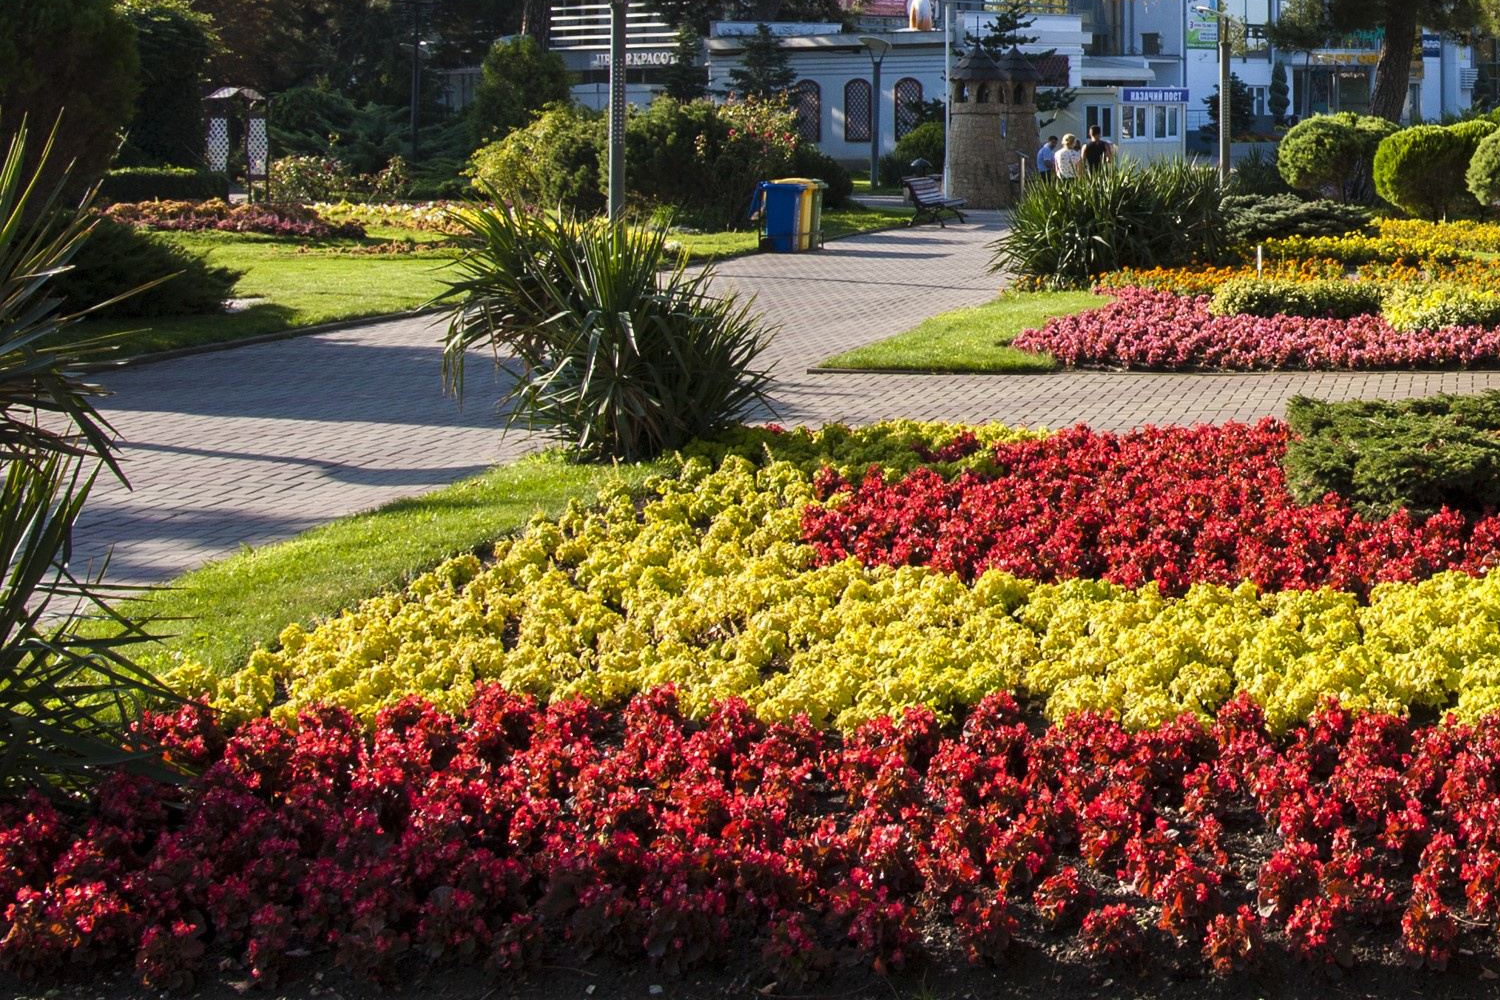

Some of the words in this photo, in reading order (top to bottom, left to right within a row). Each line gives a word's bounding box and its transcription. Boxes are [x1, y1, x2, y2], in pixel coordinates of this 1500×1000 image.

[1312, 53, 1379, 65] ТОРГОВ
[1130, 90, 1163, 101] КАЗАЧИЙ
[1164, 91, 1182, 101] ПОСТ
